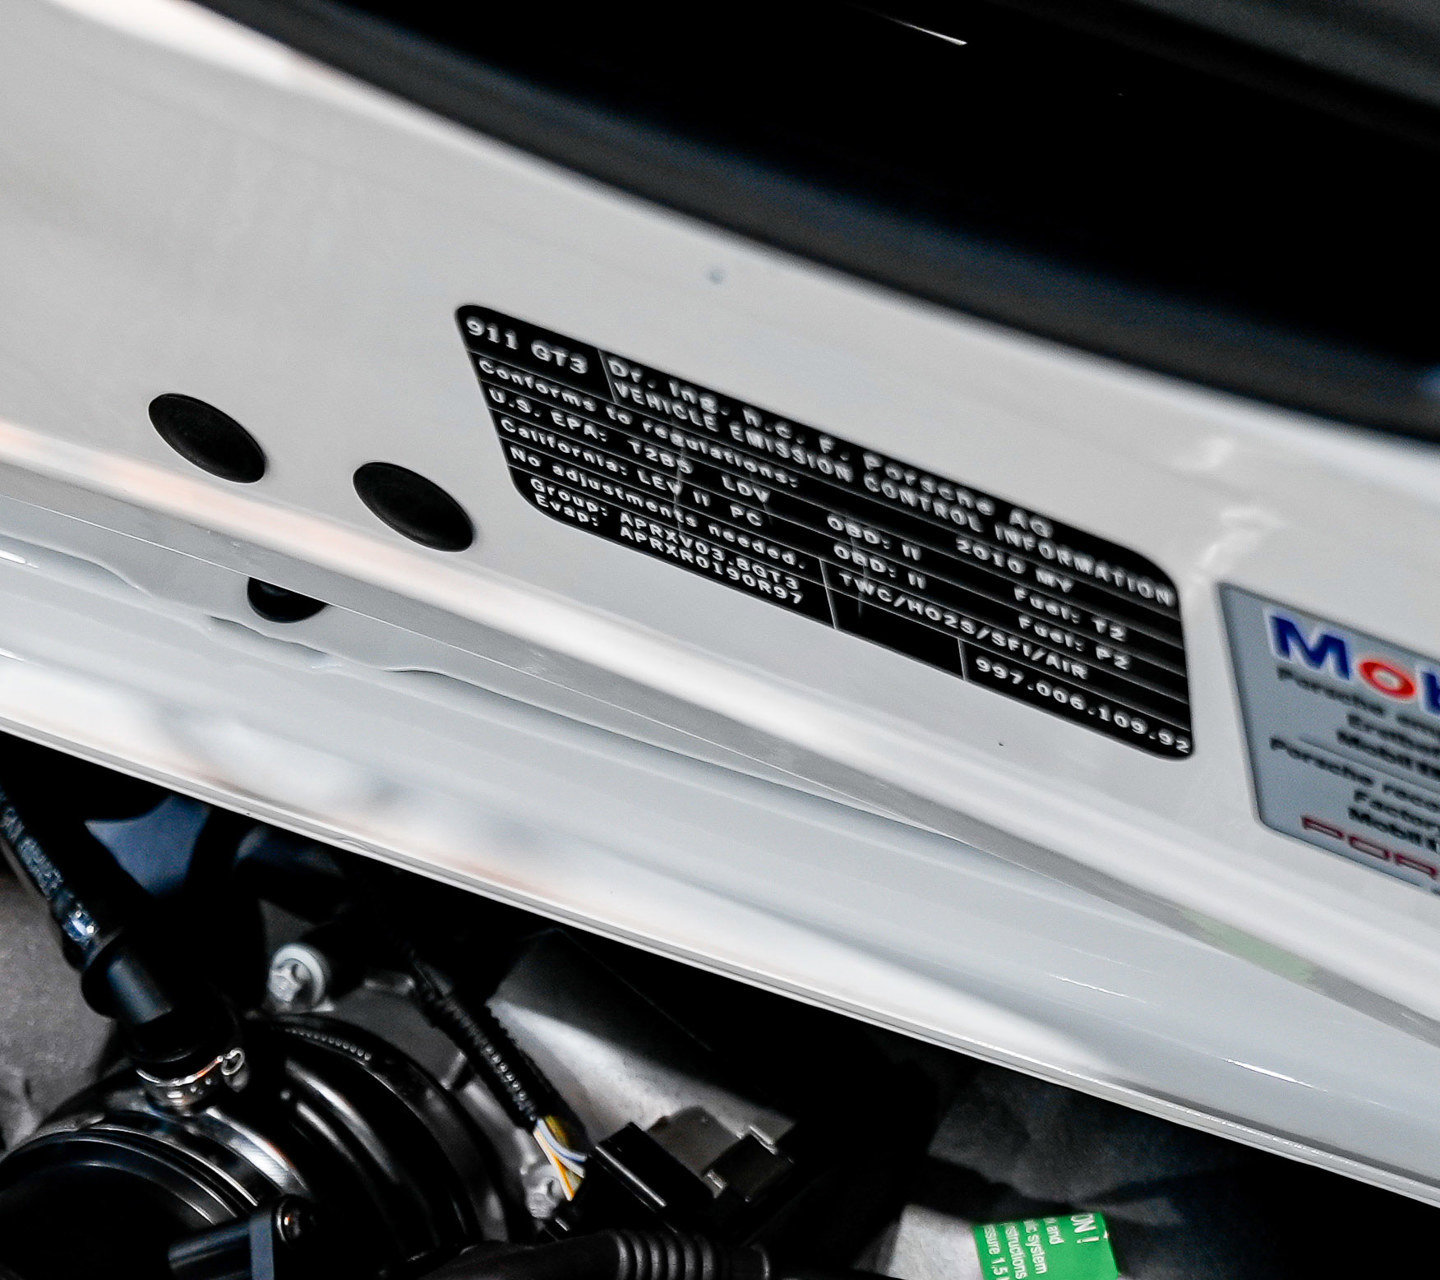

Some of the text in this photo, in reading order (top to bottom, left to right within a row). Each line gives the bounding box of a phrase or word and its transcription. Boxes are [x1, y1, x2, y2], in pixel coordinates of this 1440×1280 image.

[467, 320, 586, 373] 911 GT3
[479, 360, 594, 411] Conforms
[606, 407, 630, 424] to
[643, 423, 796, 487] regulations:
[957, 540, 1024, 573] 2010
[489, 389, 539, 417] U.S.
[551, 412, 606, 441] EPA:
[722, 476, 768, 502] LDV
[828, 516, 889, 549] OBD:
[1014, 588, 1078, 623] Fuel:
[1093, 619, 1125, 641] T2
[501, 419, 627, 475] California:
[637, 471, 681, 495] LEV
[730, 506, 761, 526] PC
[834, 545, 895, 577] OBD:
[1019, 616, 1082, 651] Fuel:
[510, 447, 540, 466] No
[553, 466, 696, 527] adjustments
[708, 525, 804, 569] needed.
[531, 479, 607, 516] Group:
[608, 360, 653, 388] Dr.
[864, 455, 992, 515] Porsche
[1010, 511, 1050, 537] AG
[614, 382, 1173, 605] VEHICLE EMISSION CONTROL INFORMATION
[535, 493, 598, 526] Evap:
[976, 659, 1189, 753] 997.006.109.92
[1025, 1234, 1047, 1274] system
[1046, 1225, 1064, 1244] and
